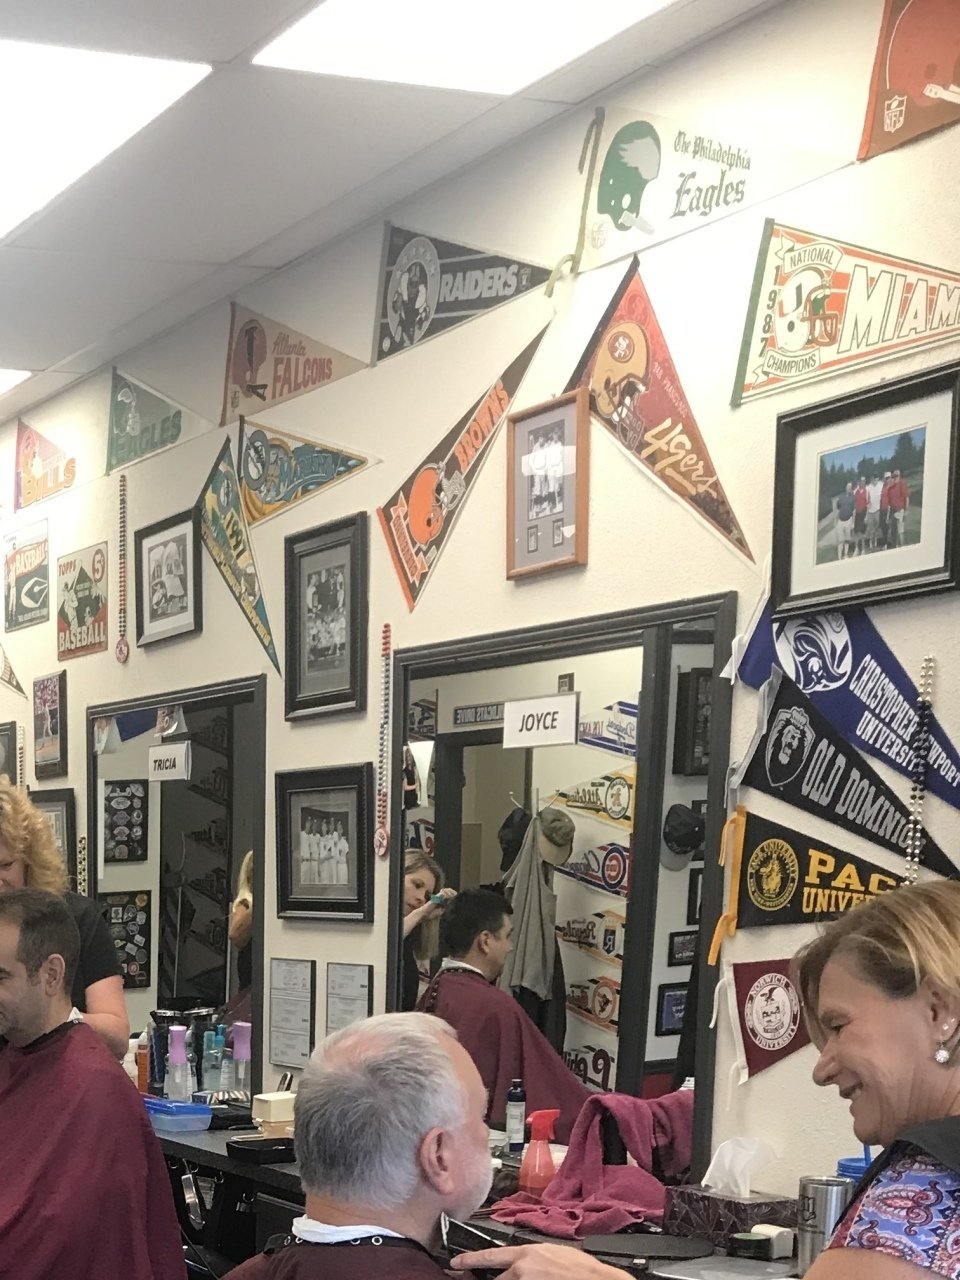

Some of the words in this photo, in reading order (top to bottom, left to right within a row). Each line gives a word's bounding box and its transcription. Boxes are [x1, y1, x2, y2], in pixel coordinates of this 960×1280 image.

[674, 130, 691, 153] The
[692, 135, 751, 171] Philadelphia
[668, 169, 746, 220] Eagles
[789, 252, 835, 269] NATIONAL
[440, 264, 519, 303] RAIDERS
[837, 264, 960, 355] MIAM
[271, 331, 307, 357] Atlanta
[766, 352, 817, 374] CHAMPIONS
[271, 356, 333, 401] FALCONS
[454, 378, 510, 475] BROWNS
[59, 559, 77, 577] TOPPS
[59, 621, 106, 653] BASEBALL
[849, 654, 920, 742] CHRISTOPHER
[518, 710, 560, 733] JOYCE
[856, 710, 922, 776] UNIVERSIT
[153, 757, 177, 772] TRICIA
[801, 738, 846, 807] OLD
[835, 767, 926, 856] DOMINIO
[805, 848, 897, 895] PAC
